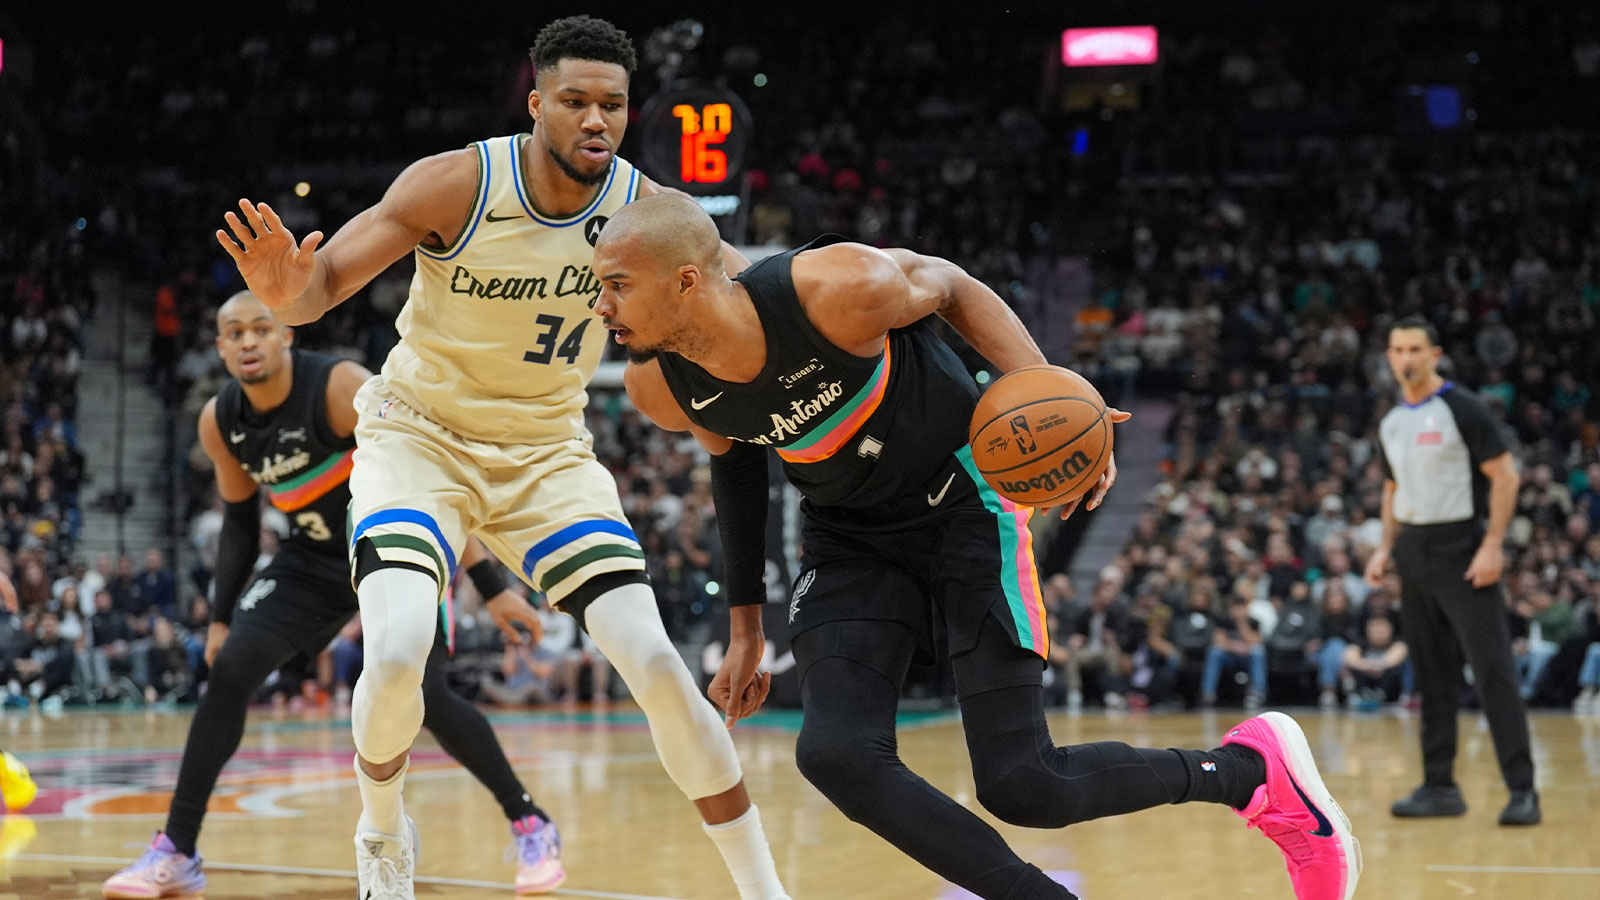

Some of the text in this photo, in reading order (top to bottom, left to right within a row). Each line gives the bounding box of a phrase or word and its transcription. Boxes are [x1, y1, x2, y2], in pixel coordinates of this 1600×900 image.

[681, 130, 728, 183] 16
[450, 265, 548, 301] Cream
[523, 313, 592, 365] 34
[785, 362, 817, 384] LEDGER
[769, 380, 843, 441] Antonio
[997, 450, 1093, 494] Wilson
[296, 511, 332, 541] 3
